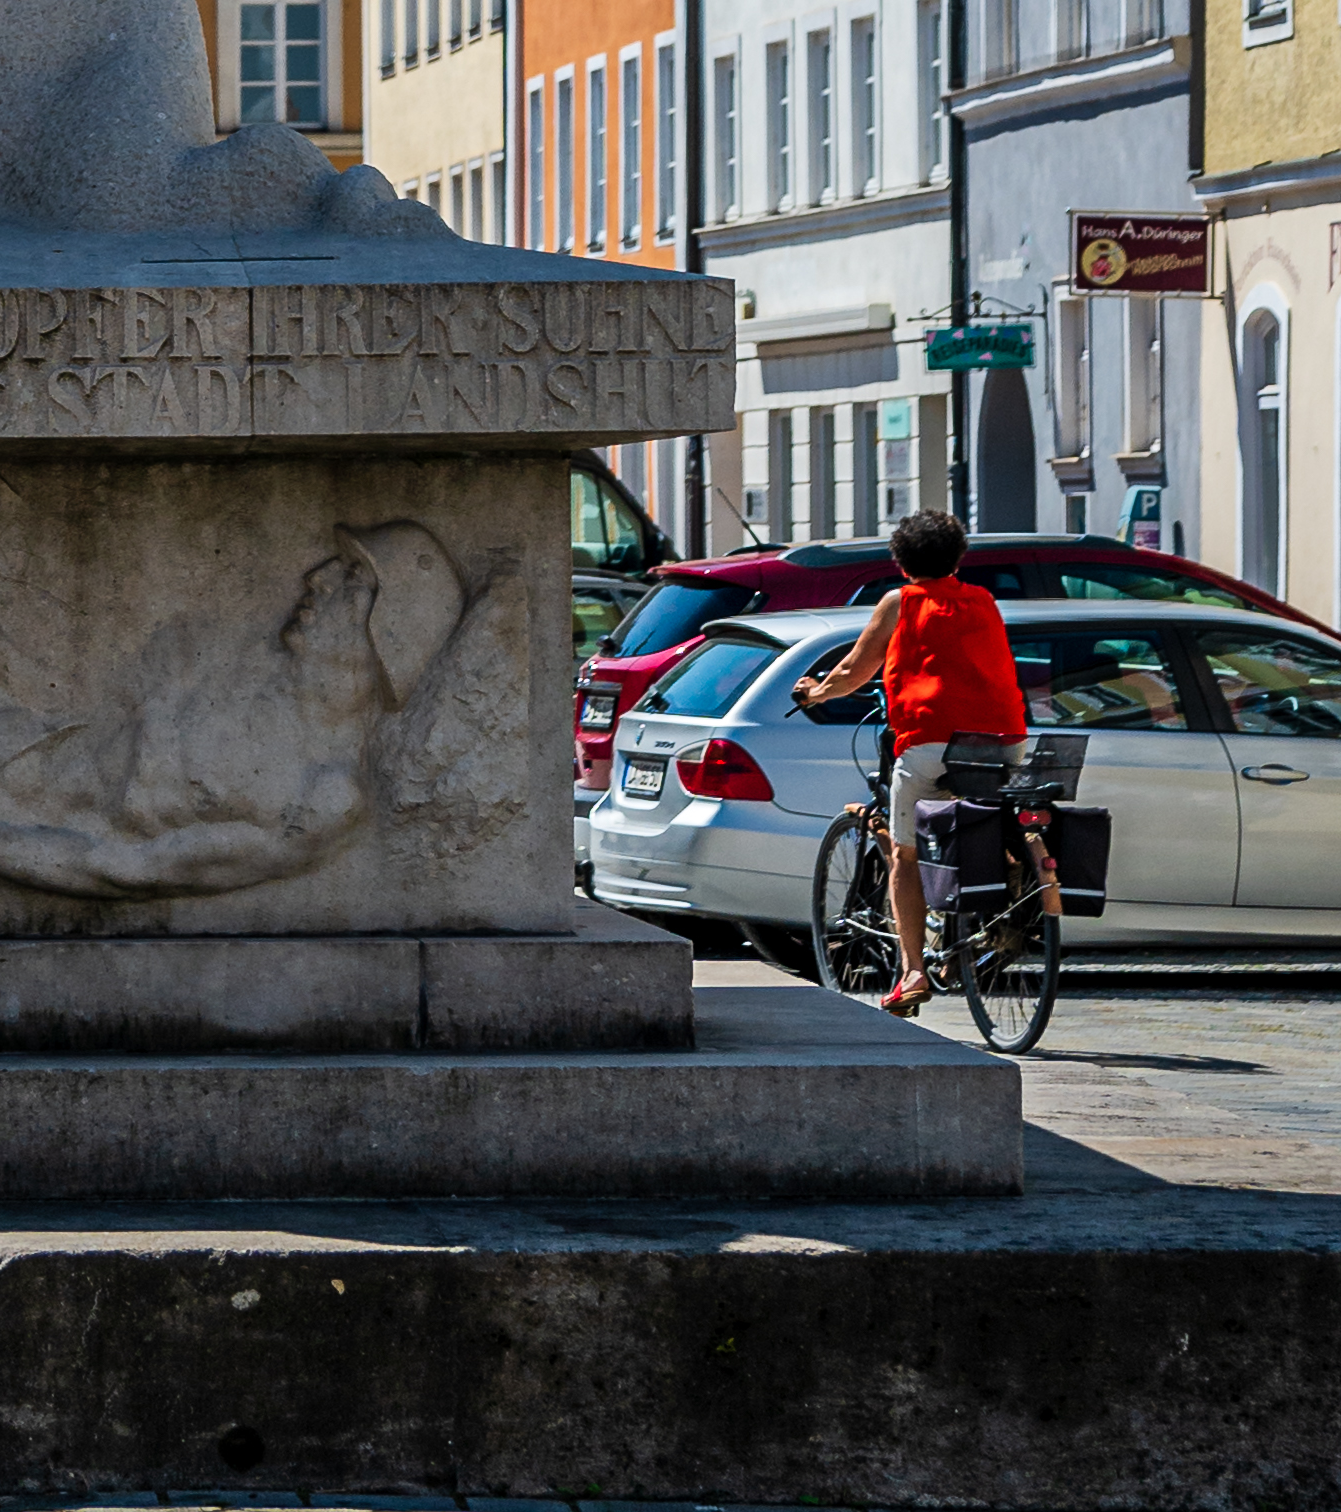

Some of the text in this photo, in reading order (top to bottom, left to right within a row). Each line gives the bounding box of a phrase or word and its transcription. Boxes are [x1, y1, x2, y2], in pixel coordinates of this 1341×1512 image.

[1081, 224, 1117, 238] Hans
[247, 284, 470, 357] IHRER
[47, 365, 297, 437] STADT
[344, 360, 732, 434] LANDSHUT
[1141, 493, 1157, 517] P
